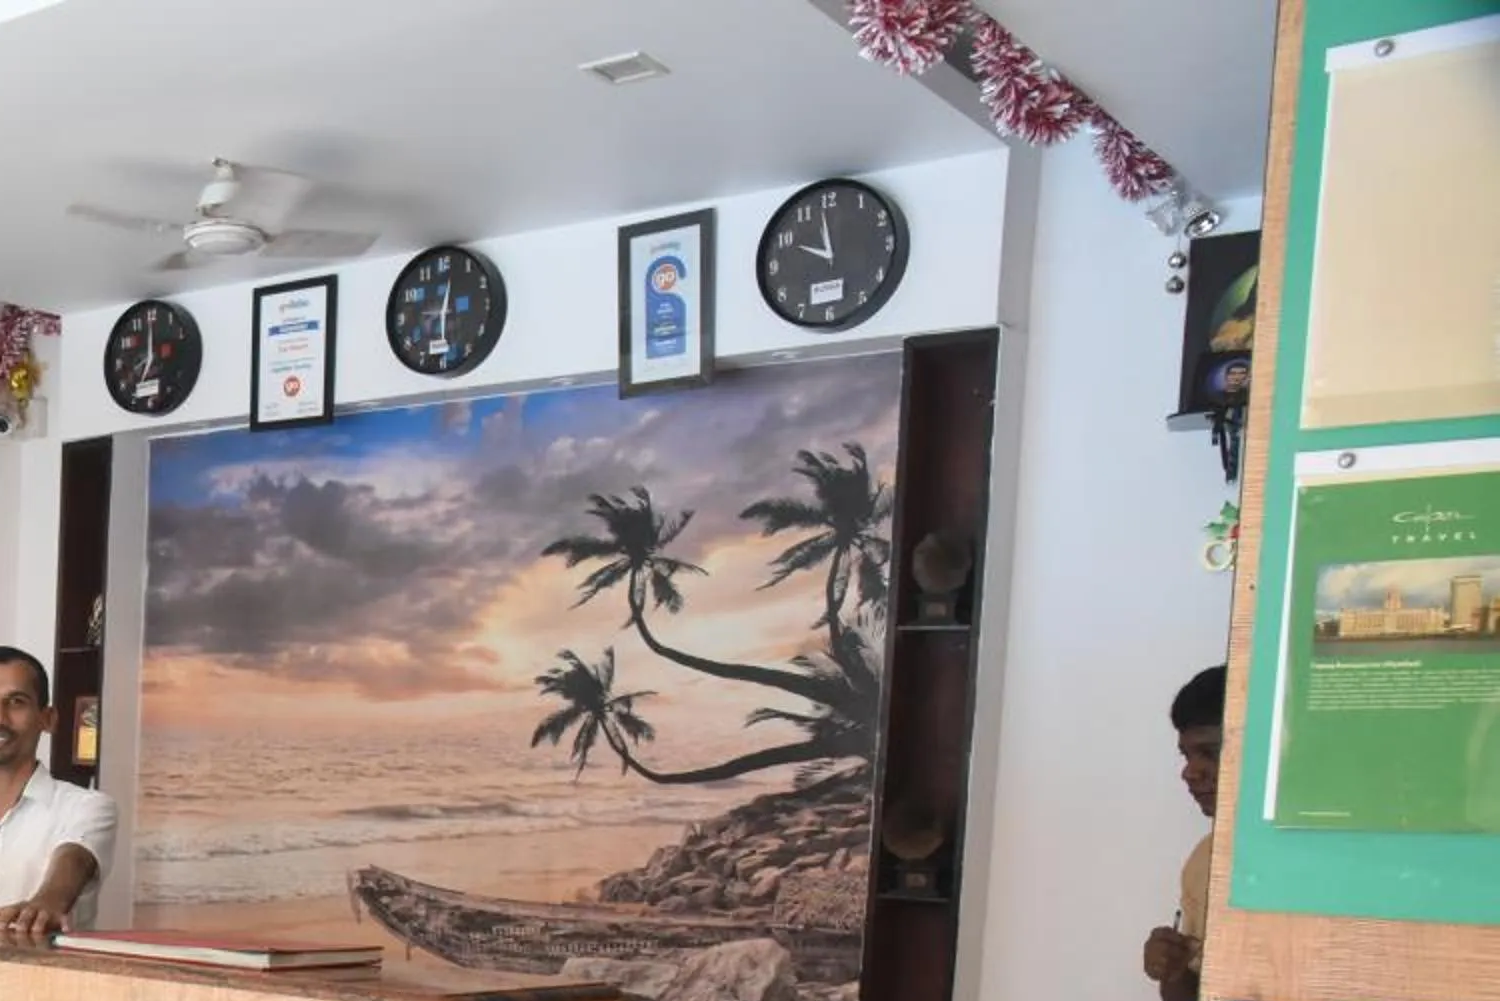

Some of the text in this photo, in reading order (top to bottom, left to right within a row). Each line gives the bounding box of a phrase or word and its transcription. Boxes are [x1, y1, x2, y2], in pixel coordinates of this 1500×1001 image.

[821, 191, 837, 209] 12
[857, 193, 864, 209] 1
[797, 205, 811, 222] 11
[876, 209, 888, 227] 2
[778, 231, 793, 248] 10
[885, 234, 895, 251] 3
[420, 266, 431, 282] 11
[769, 259, 779, 276] 9
[875, 267, 884, 283] 4
[405, 288, 417, 303] 10
[777, 287, 787, 303] 8
[858, 290, 868, 305] 5
[797, 303, 805, 319] 7
[825, 306, 835, 321] 6
[1391, 531, 1477, 545] TRAVEL
